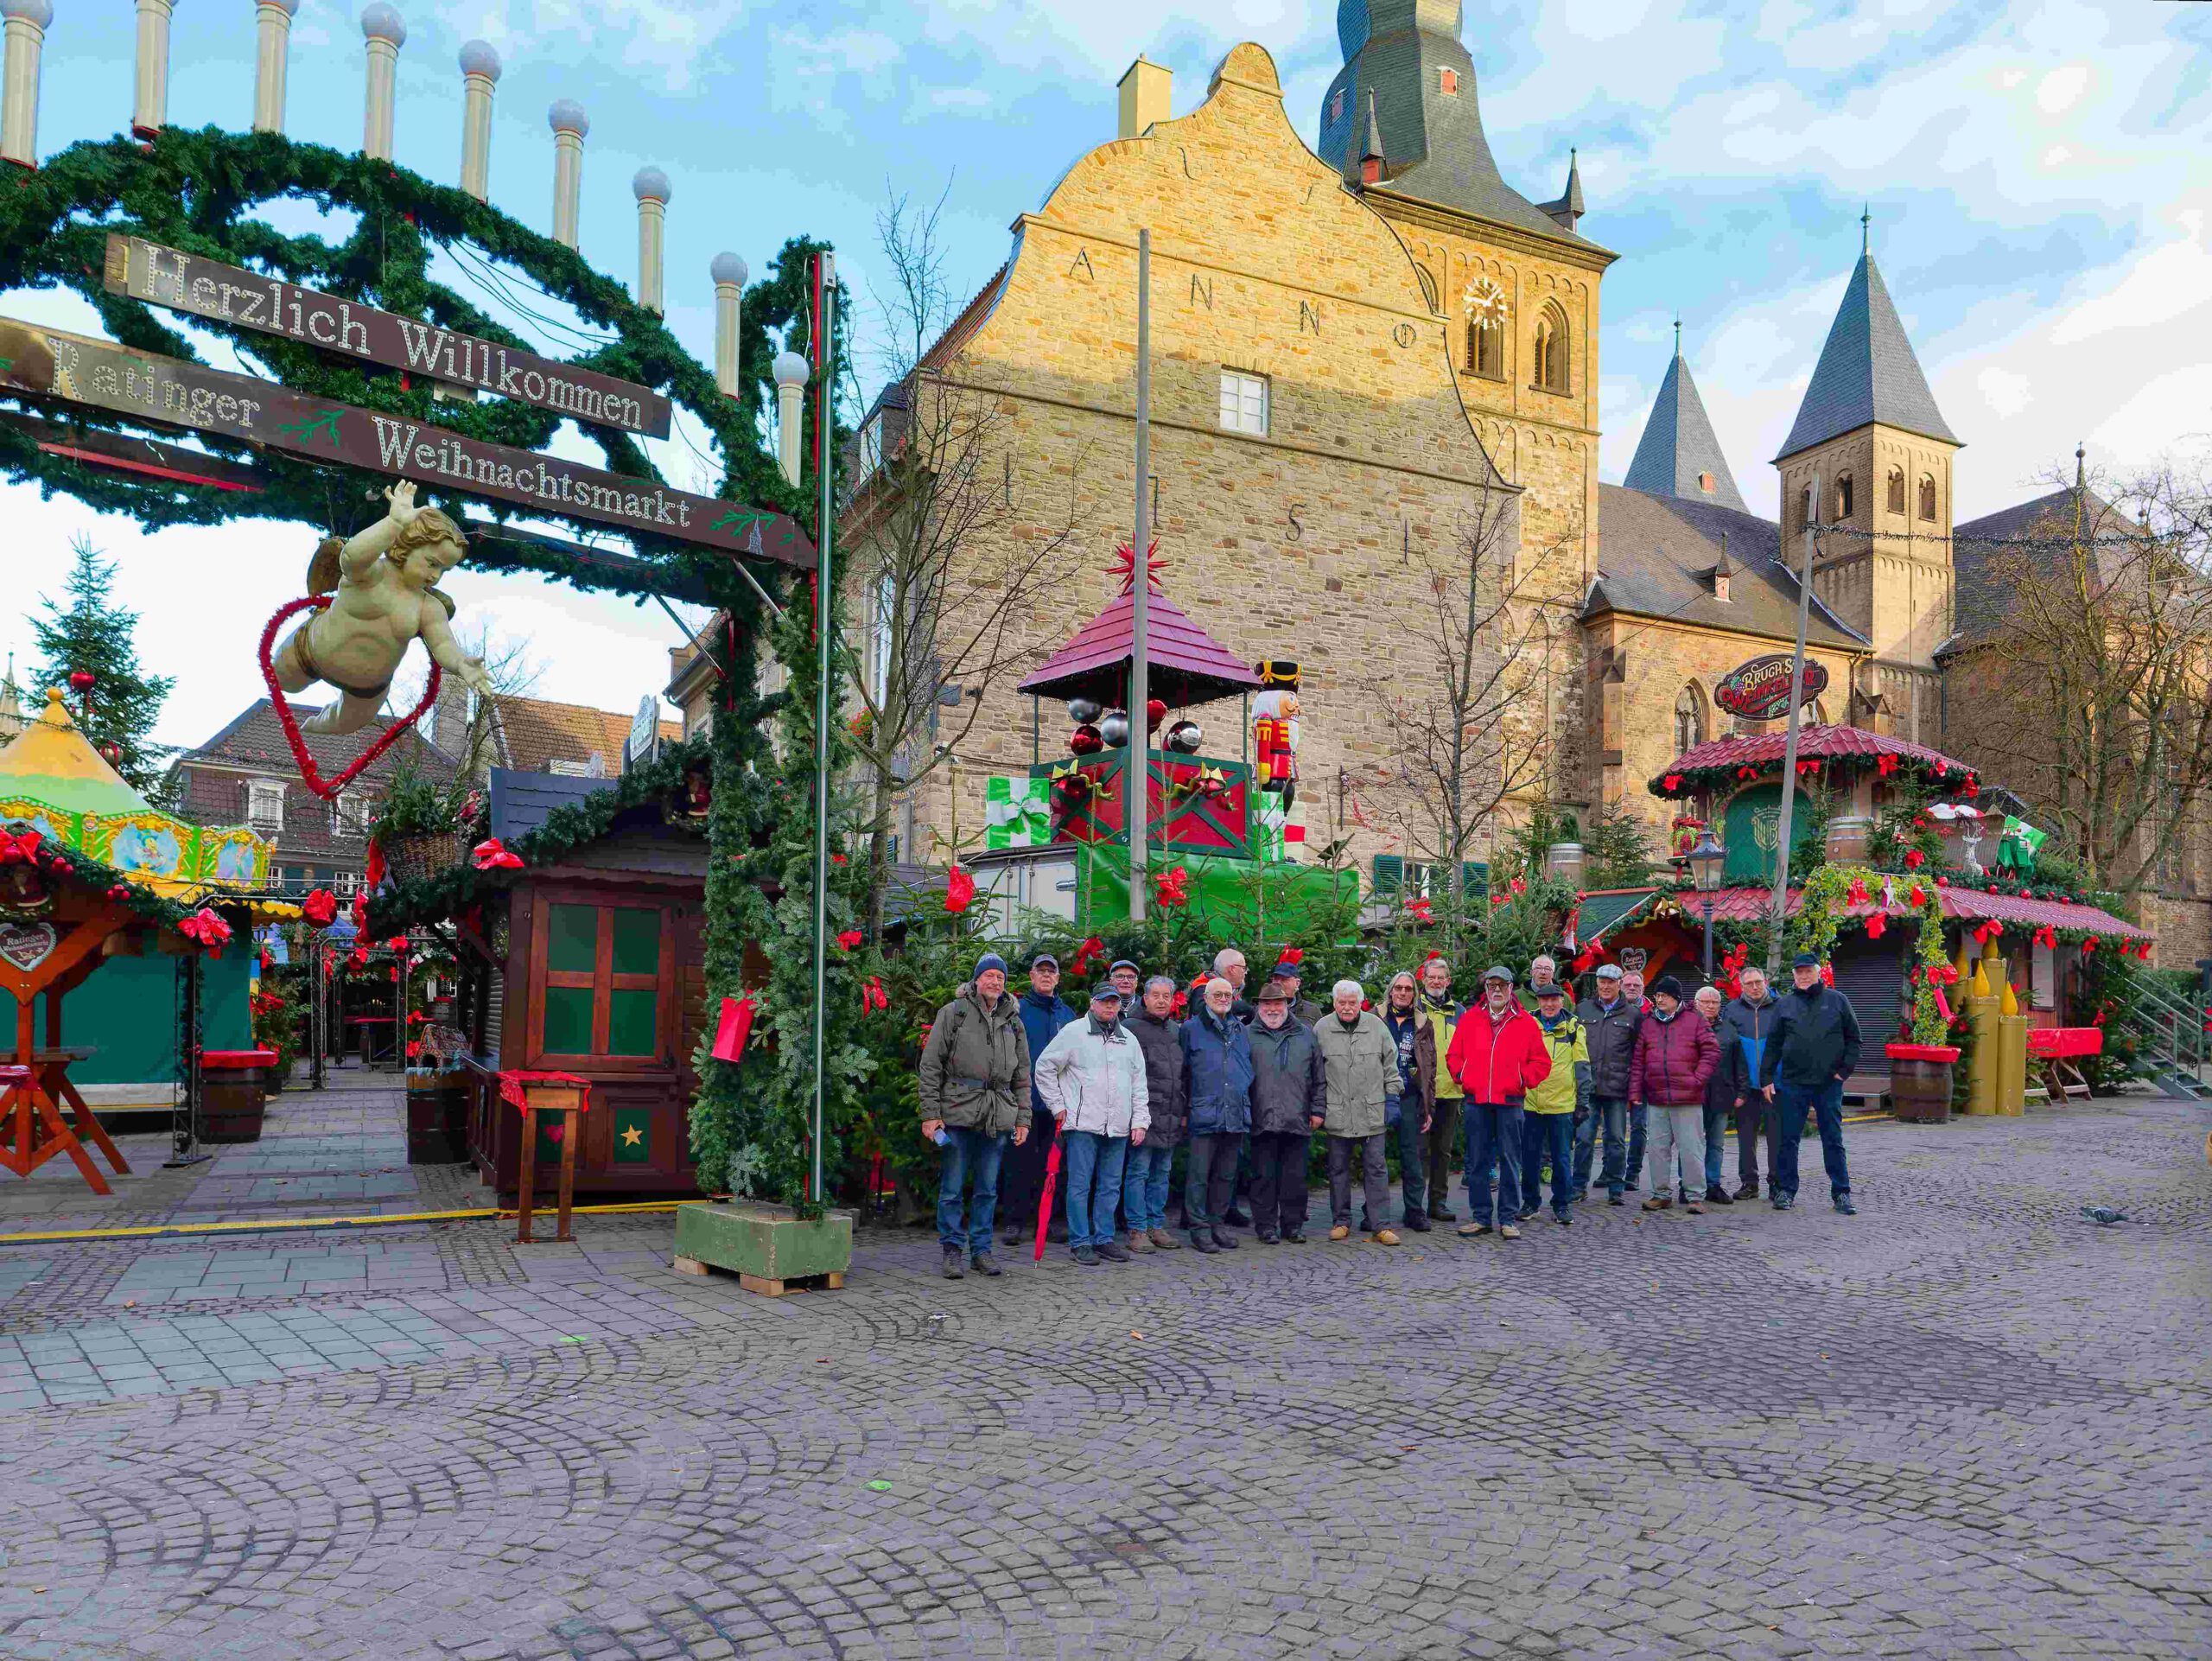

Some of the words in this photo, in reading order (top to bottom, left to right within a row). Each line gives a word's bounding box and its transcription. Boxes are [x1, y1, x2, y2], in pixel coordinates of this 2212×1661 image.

[141, 243, 372, 355] Herzlich
[396, 319, 642, 430] Willkommen
[48, 337, 262, 429] Ratinger
[372, 416, 691, 528] Weihnachtsmarkt
[7, 934, 44, 945] Ratinger
